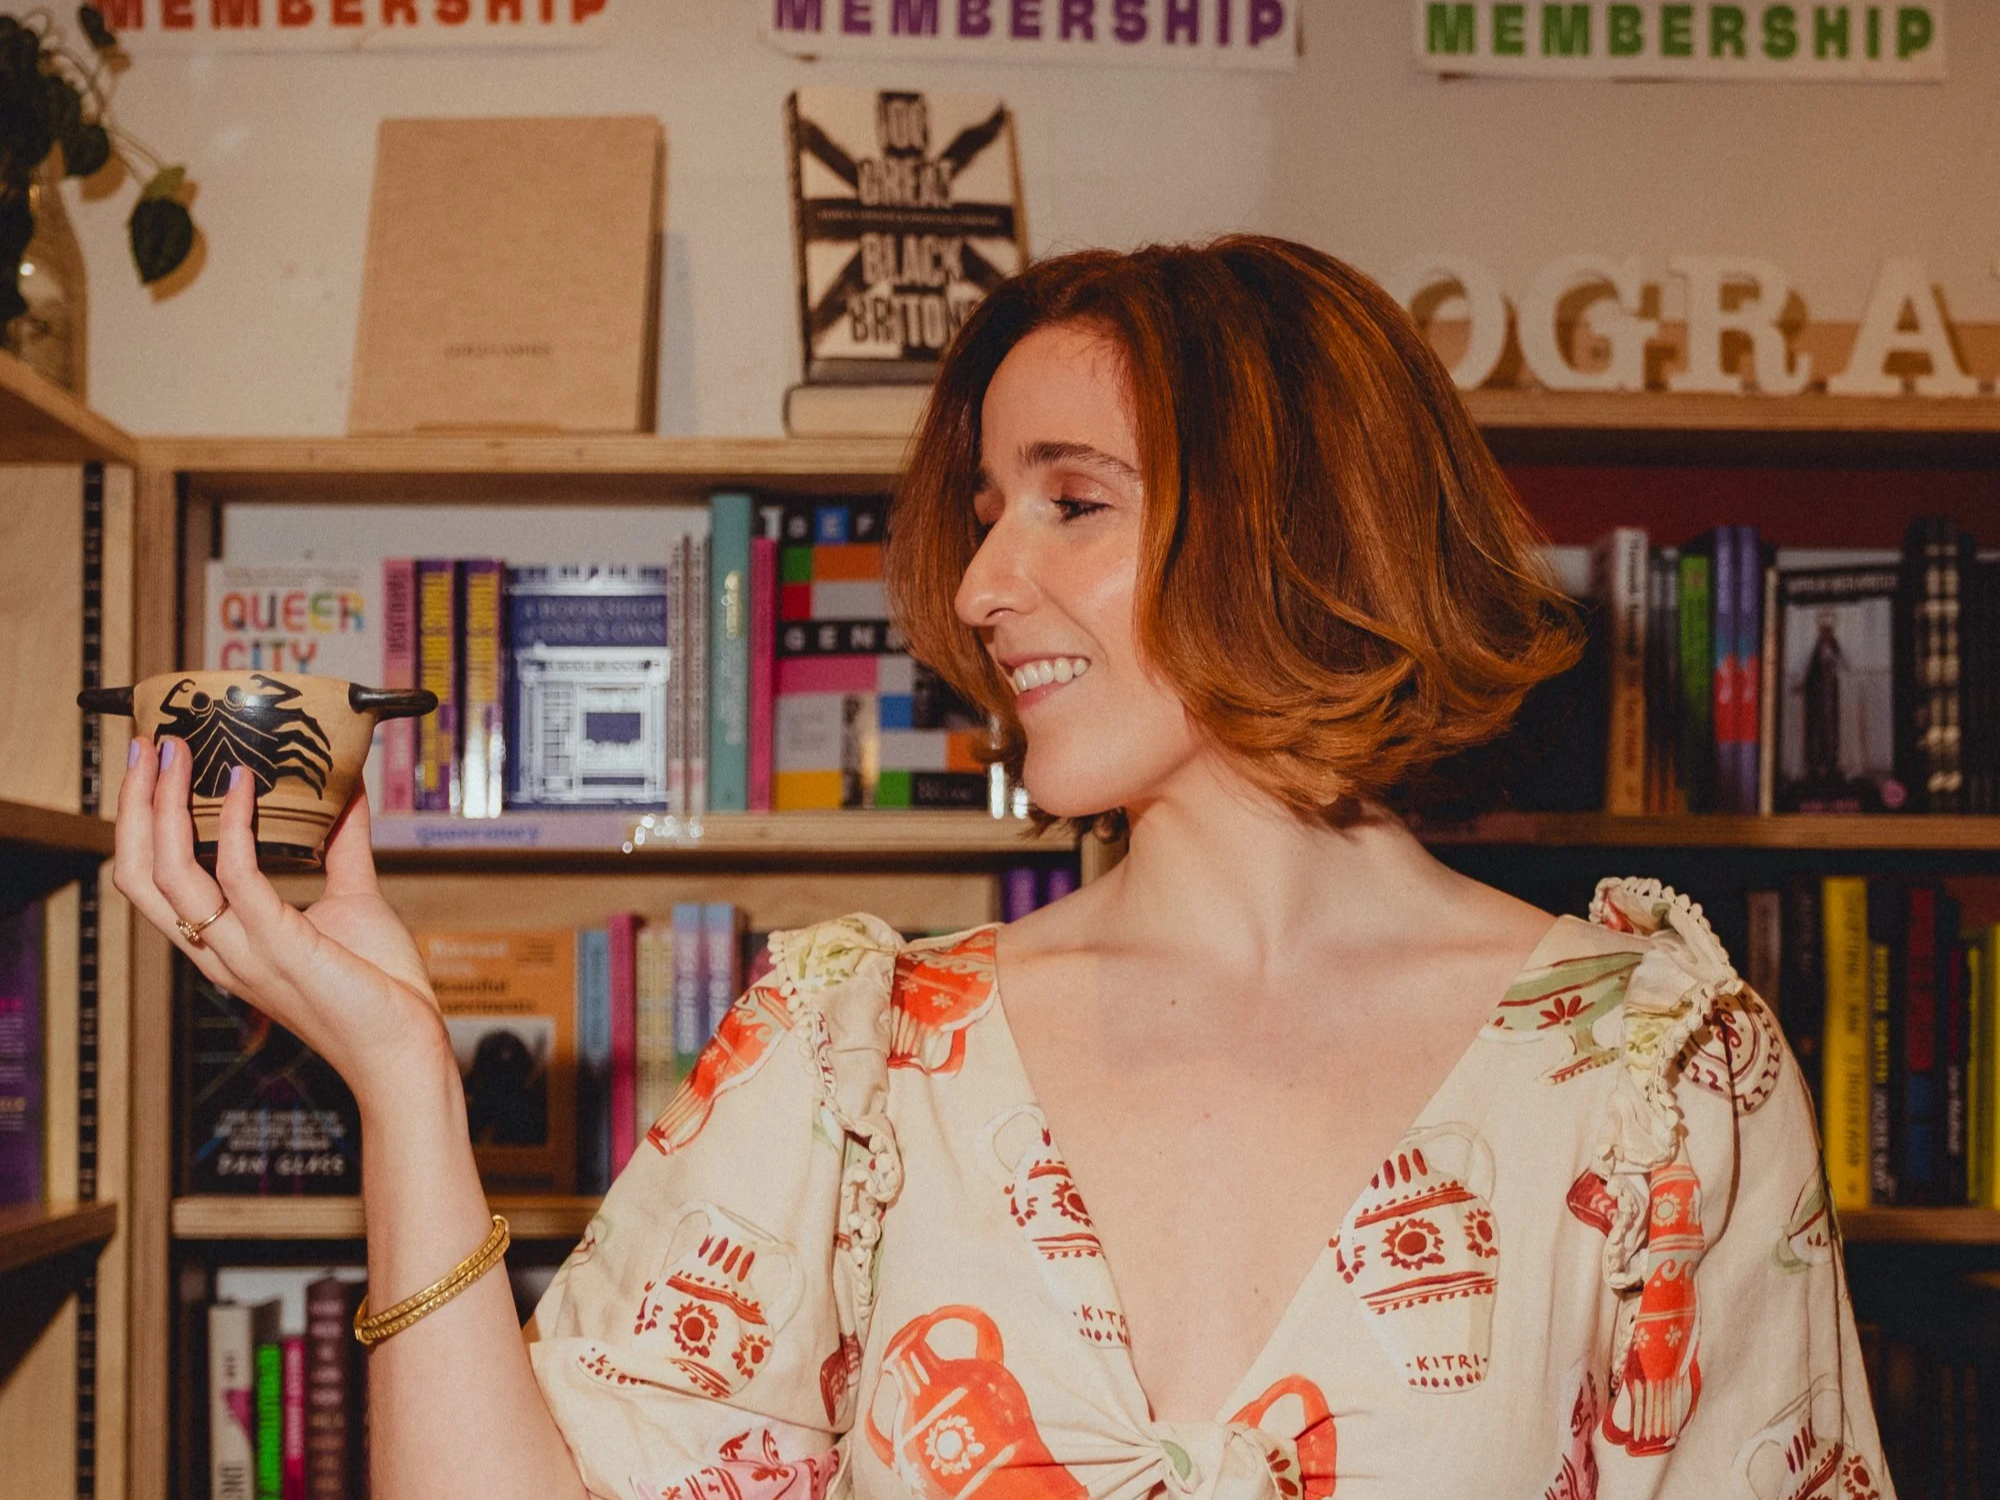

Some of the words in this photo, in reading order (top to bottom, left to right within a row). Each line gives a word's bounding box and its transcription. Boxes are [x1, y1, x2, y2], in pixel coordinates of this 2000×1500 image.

[773, 0, 1288, 48] MEMBERSHIP
[1425, 2, 1936, 60] MEMBERSHIP
[857, 157, 956, 208] GREAT
[859, 232, 964, 287] BLACK
[219, 590, 366, 634] QUEER
[219, 636, 318, 674] CITY
[1415, 1353, 1480, 1372] KITRI
